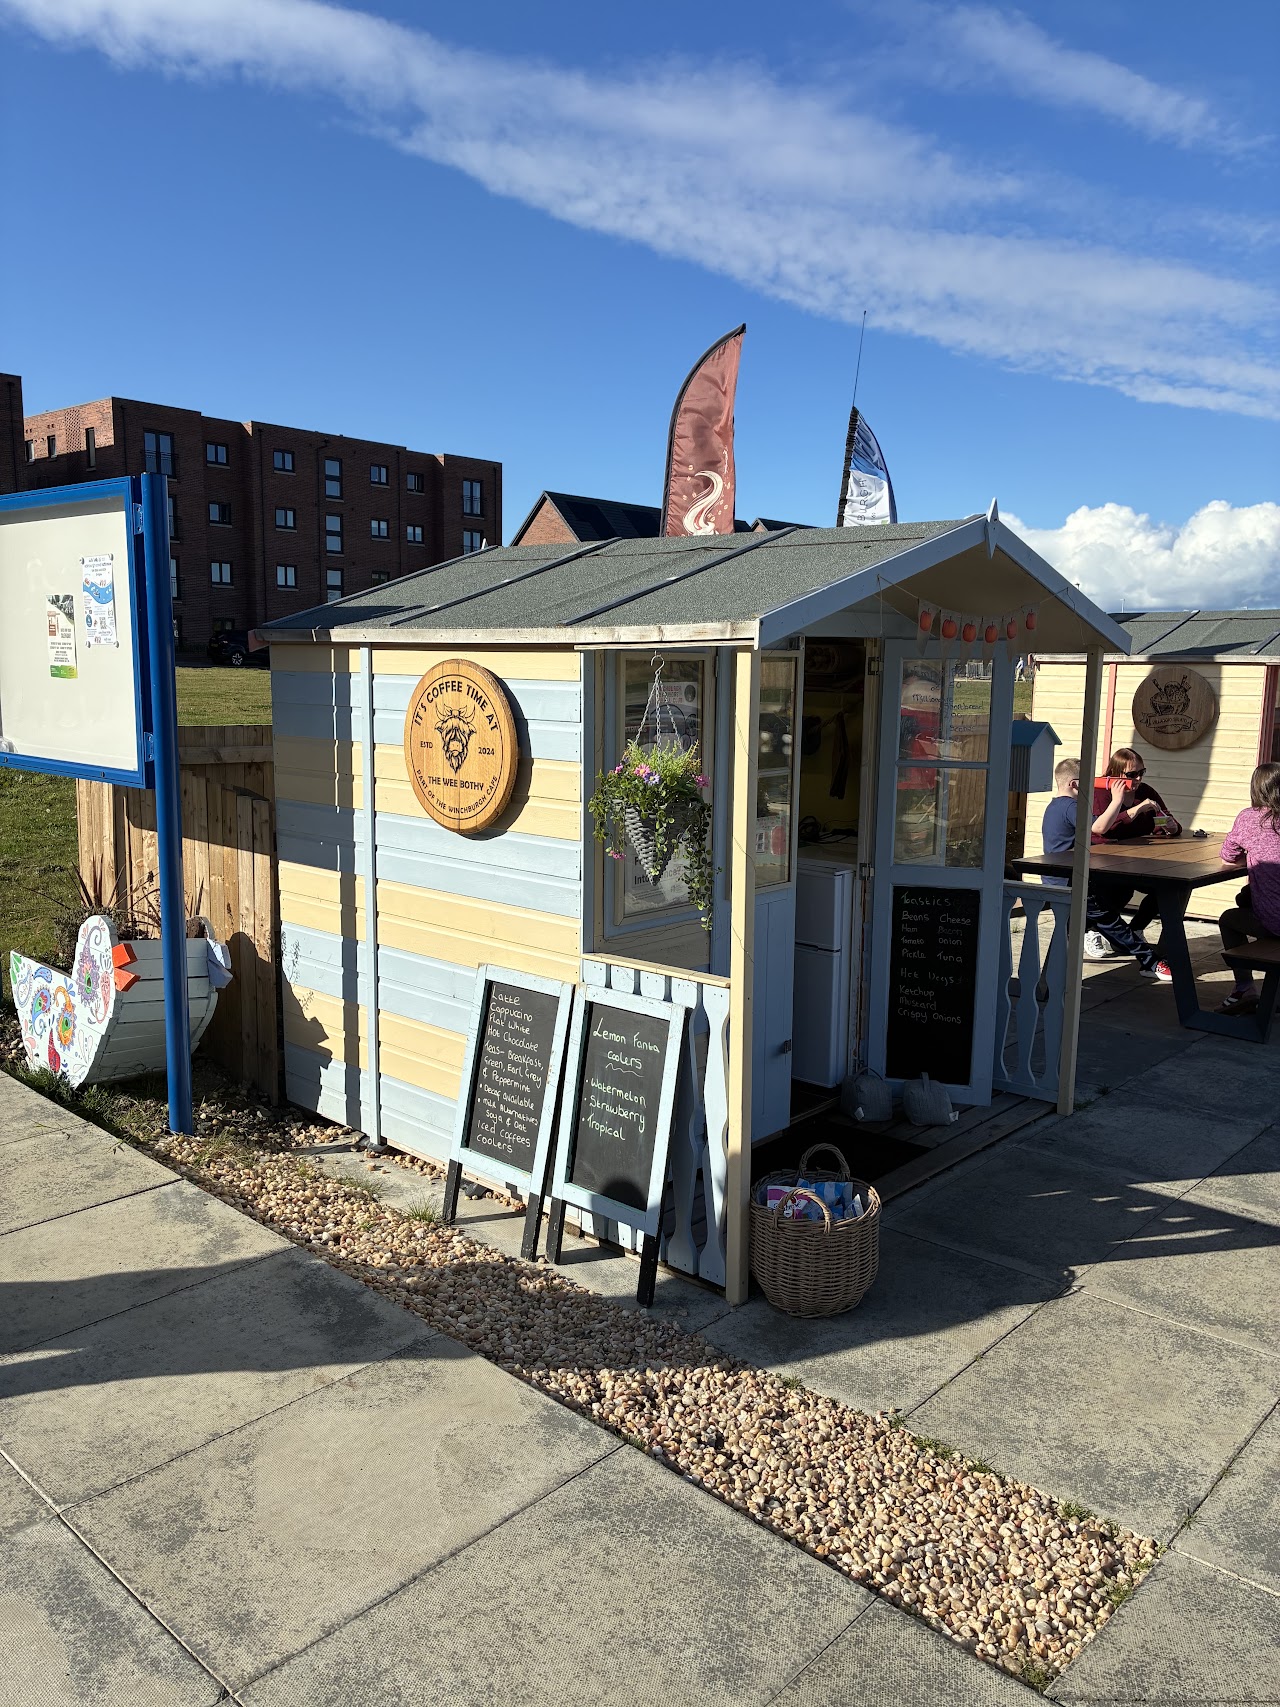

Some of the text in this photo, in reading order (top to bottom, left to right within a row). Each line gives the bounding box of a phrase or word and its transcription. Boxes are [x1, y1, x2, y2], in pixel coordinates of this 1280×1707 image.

[414, 680, 499, 731] IT'S COFFEE TIME AT
[420, 741, 433, 749] ESTD
[478, 746, 495, 756] 2024
[416, 769, 428, 790] PART
[427, 790, 435, 799] OF
[435, 798, 447, 810] THE
[448, 795, 487, 814] WINCHBURGH
[428, 776, 484, 791] THE WEE BOTHY
[901, 910, 971, 926] Beans Cheese
[901, 924, 962, 936] Ham Bacon
[901, 936, 925, 945] Tomato
[901, 948, 963, 963] Pickle Tuna
[900, 967, 919, 979] Hot
[491, 985, 521, 1006] Latte
[899, 984, 935, 1000] Ketchup
[489, 1002, 533, 1022] Cappuccino
[899, 996, 937, 1011] Mustard
[489, 1012, 531, 1035] Flat White
[897, 1007, 928, 1024] Crispy
[487, 1025, 539, 1052] Hot Chocolate
[592, 1017, 660, 1053] Lemon Fanta
[492, 1070, 531, 1093] Peppermint
[507, 1064, 524, 1078] Earl
[525, 1068, 542, 1089] Grey
[484, 1084, 502, 1101] Decaf
[590, 1078, 647, 1108] Watermelon
[499, 1104, 539, 1126] Alternatives
[589, 1095, 645, 1133] Strawberry
[477, 1120, 496, 1134] Iced
[513, 1121, 528, 1133] Oat
[587, 1113, 626, 1141] Tropical
